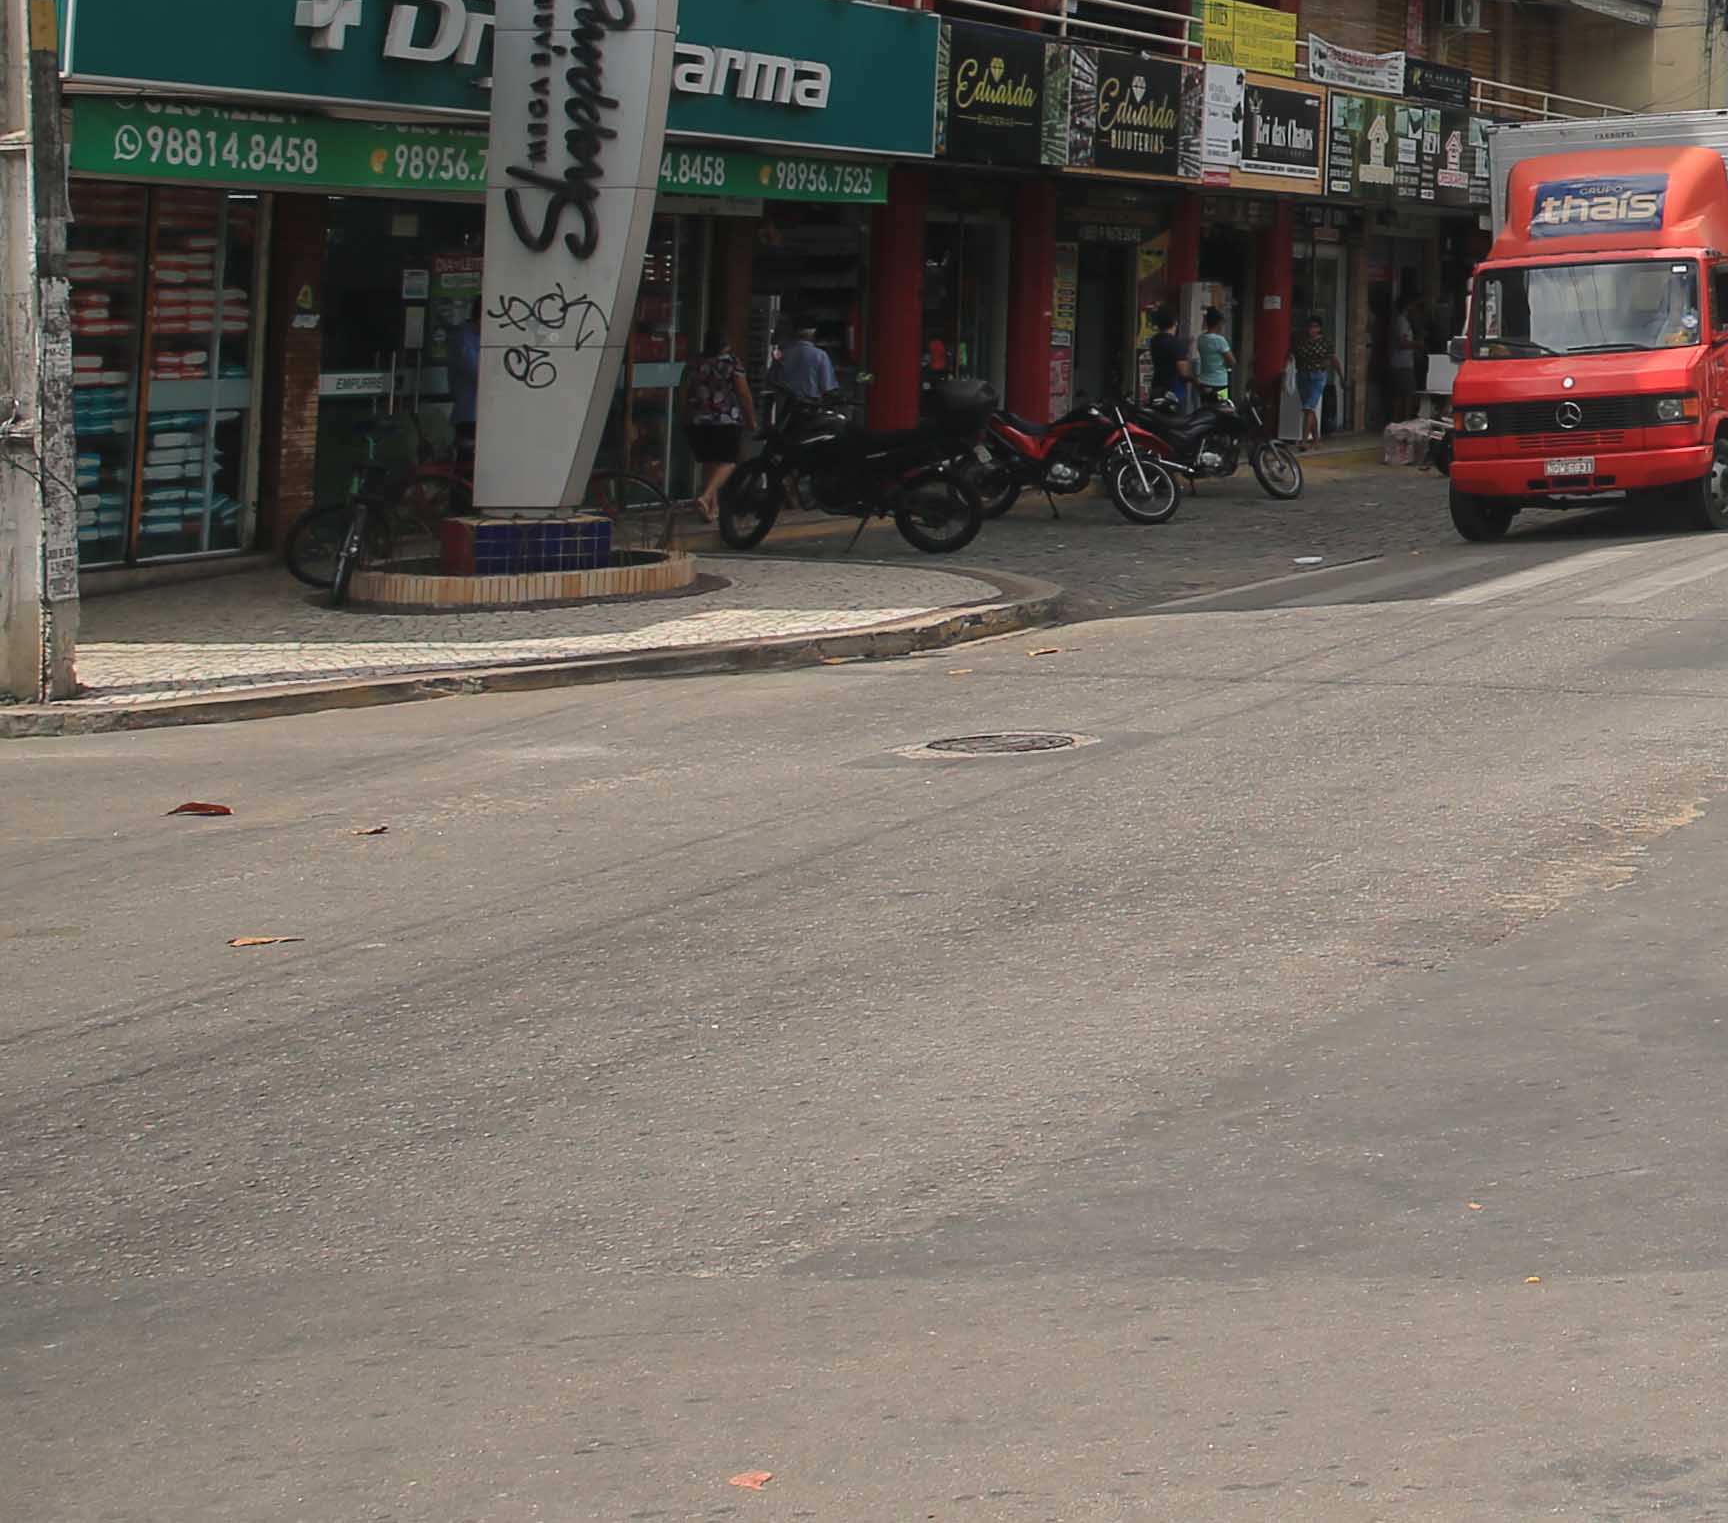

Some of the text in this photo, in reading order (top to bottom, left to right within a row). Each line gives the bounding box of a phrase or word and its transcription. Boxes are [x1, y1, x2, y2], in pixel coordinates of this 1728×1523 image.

[956, 58, 1038, 109] Eduarda
[1098, 78, 1178, 132] Eduarda
[147, 125, 319, 175] 98814.8458
[1111, 128, 1166, 155] BIJUTERIAS
[394, 143, 489, 181] 98956.7
[775, 160, 873, 195] 98956.7525
[1541, 190, 1658, 225] thaís
[1579, 185, 1624, 196] GRUPO
